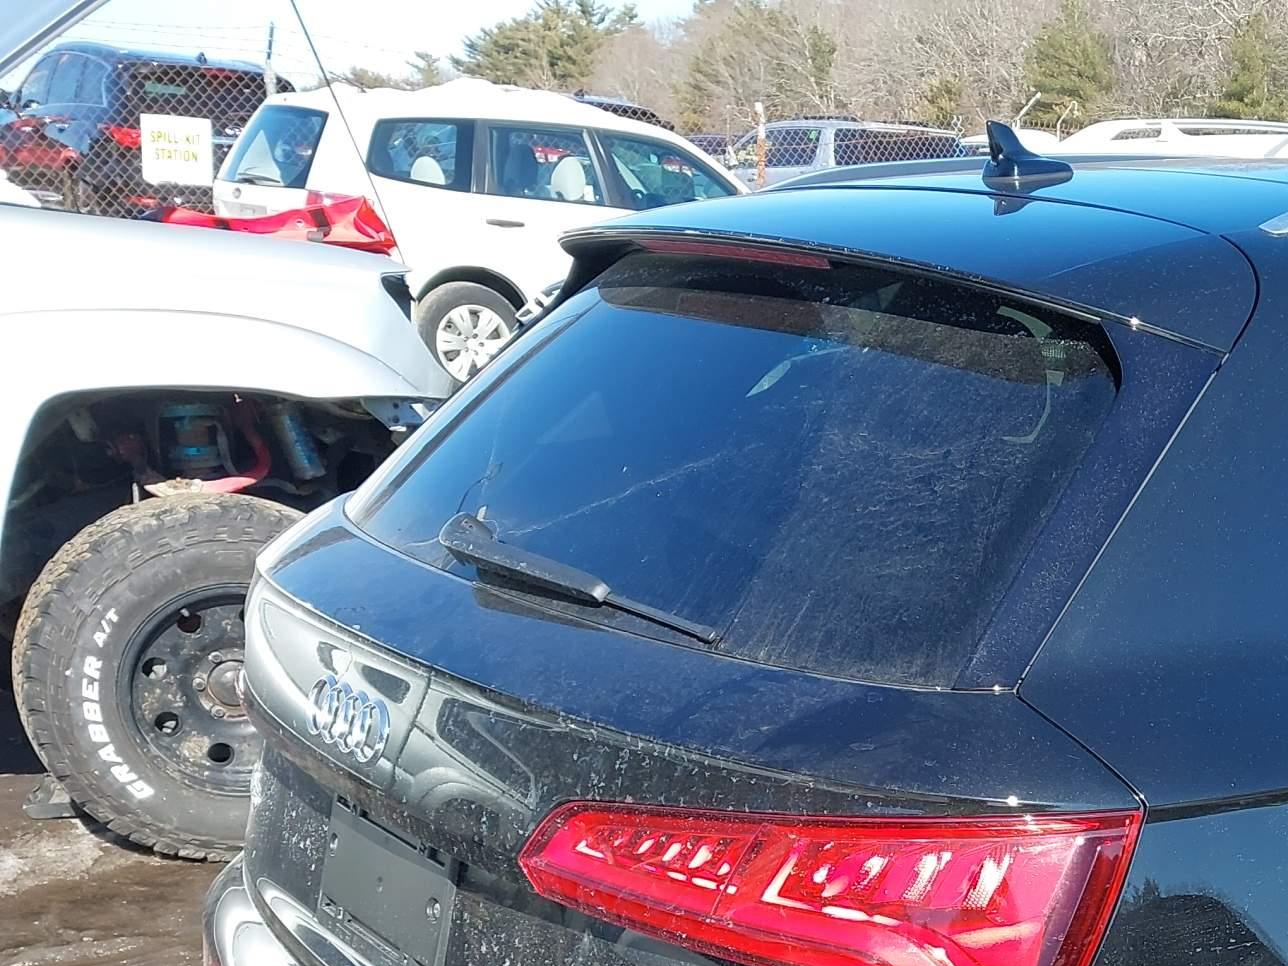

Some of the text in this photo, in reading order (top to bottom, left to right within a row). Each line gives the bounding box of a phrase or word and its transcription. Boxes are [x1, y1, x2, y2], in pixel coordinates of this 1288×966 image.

[150, 130, 201, 145] SPILL KIT
[155, 147, 198, 162] STATION
[82, 607, 155, 799] GRABBER A/T
